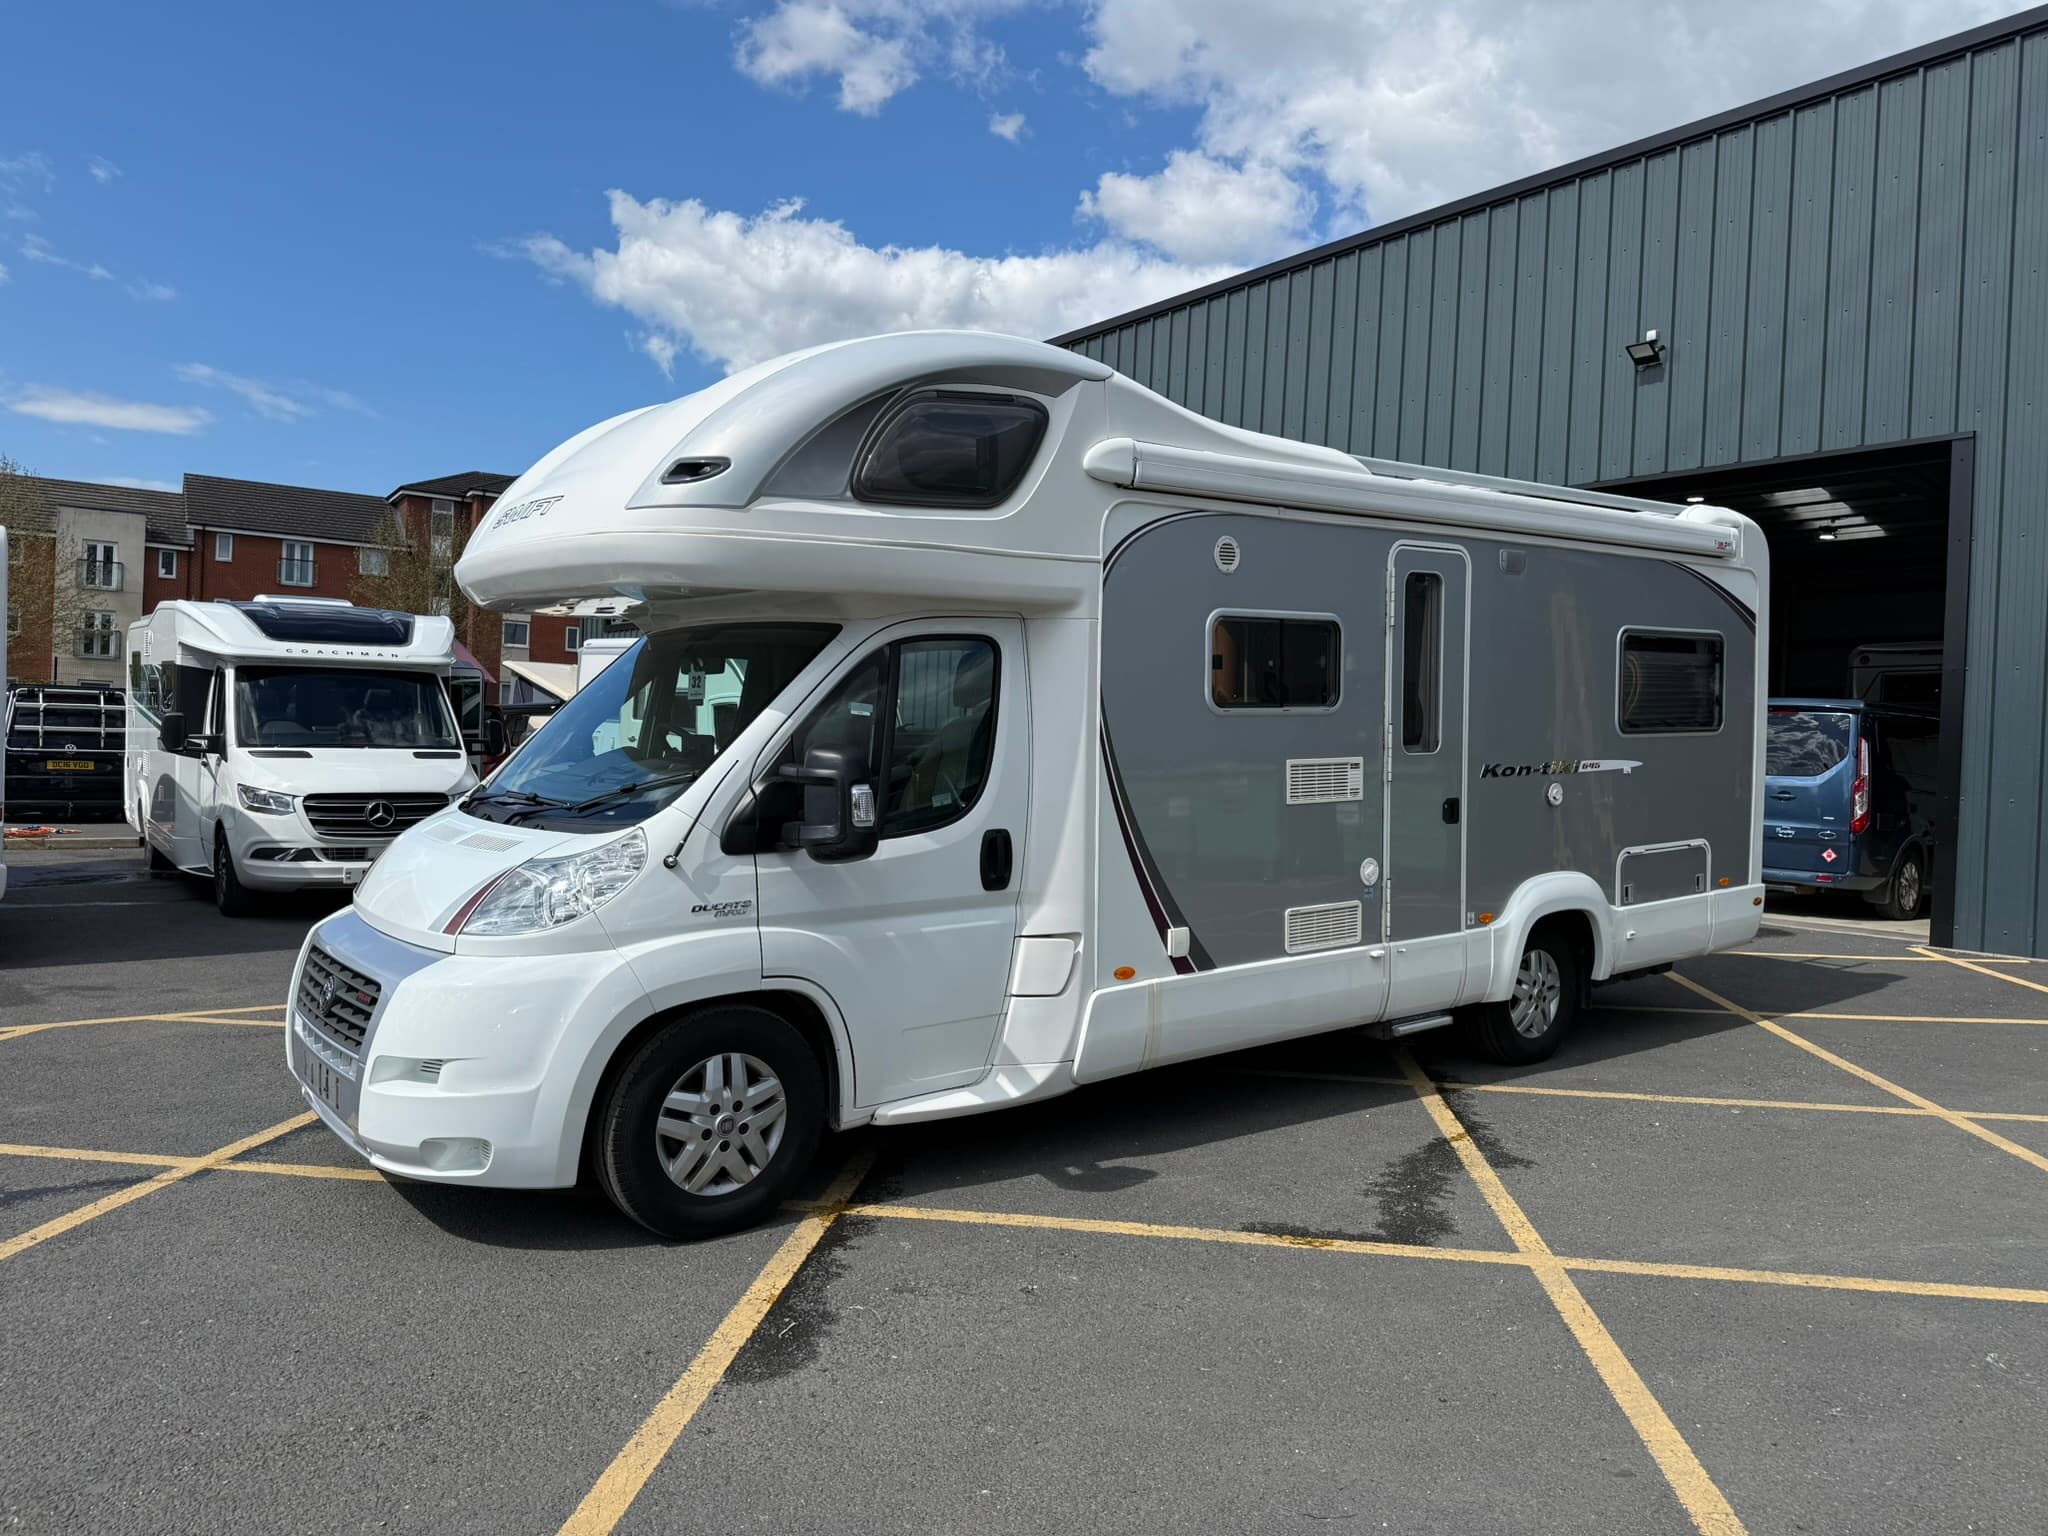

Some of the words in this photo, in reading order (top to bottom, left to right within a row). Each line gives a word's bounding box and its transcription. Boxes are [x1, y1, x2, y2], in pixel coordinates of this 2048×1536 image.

[285, 648, 399, 658] COACHMAN
[691, 675, 702, 688] 32
[1480, 759, 1579, 779] Kon-tiki
[691, 900, 752, 913] DUCATO
